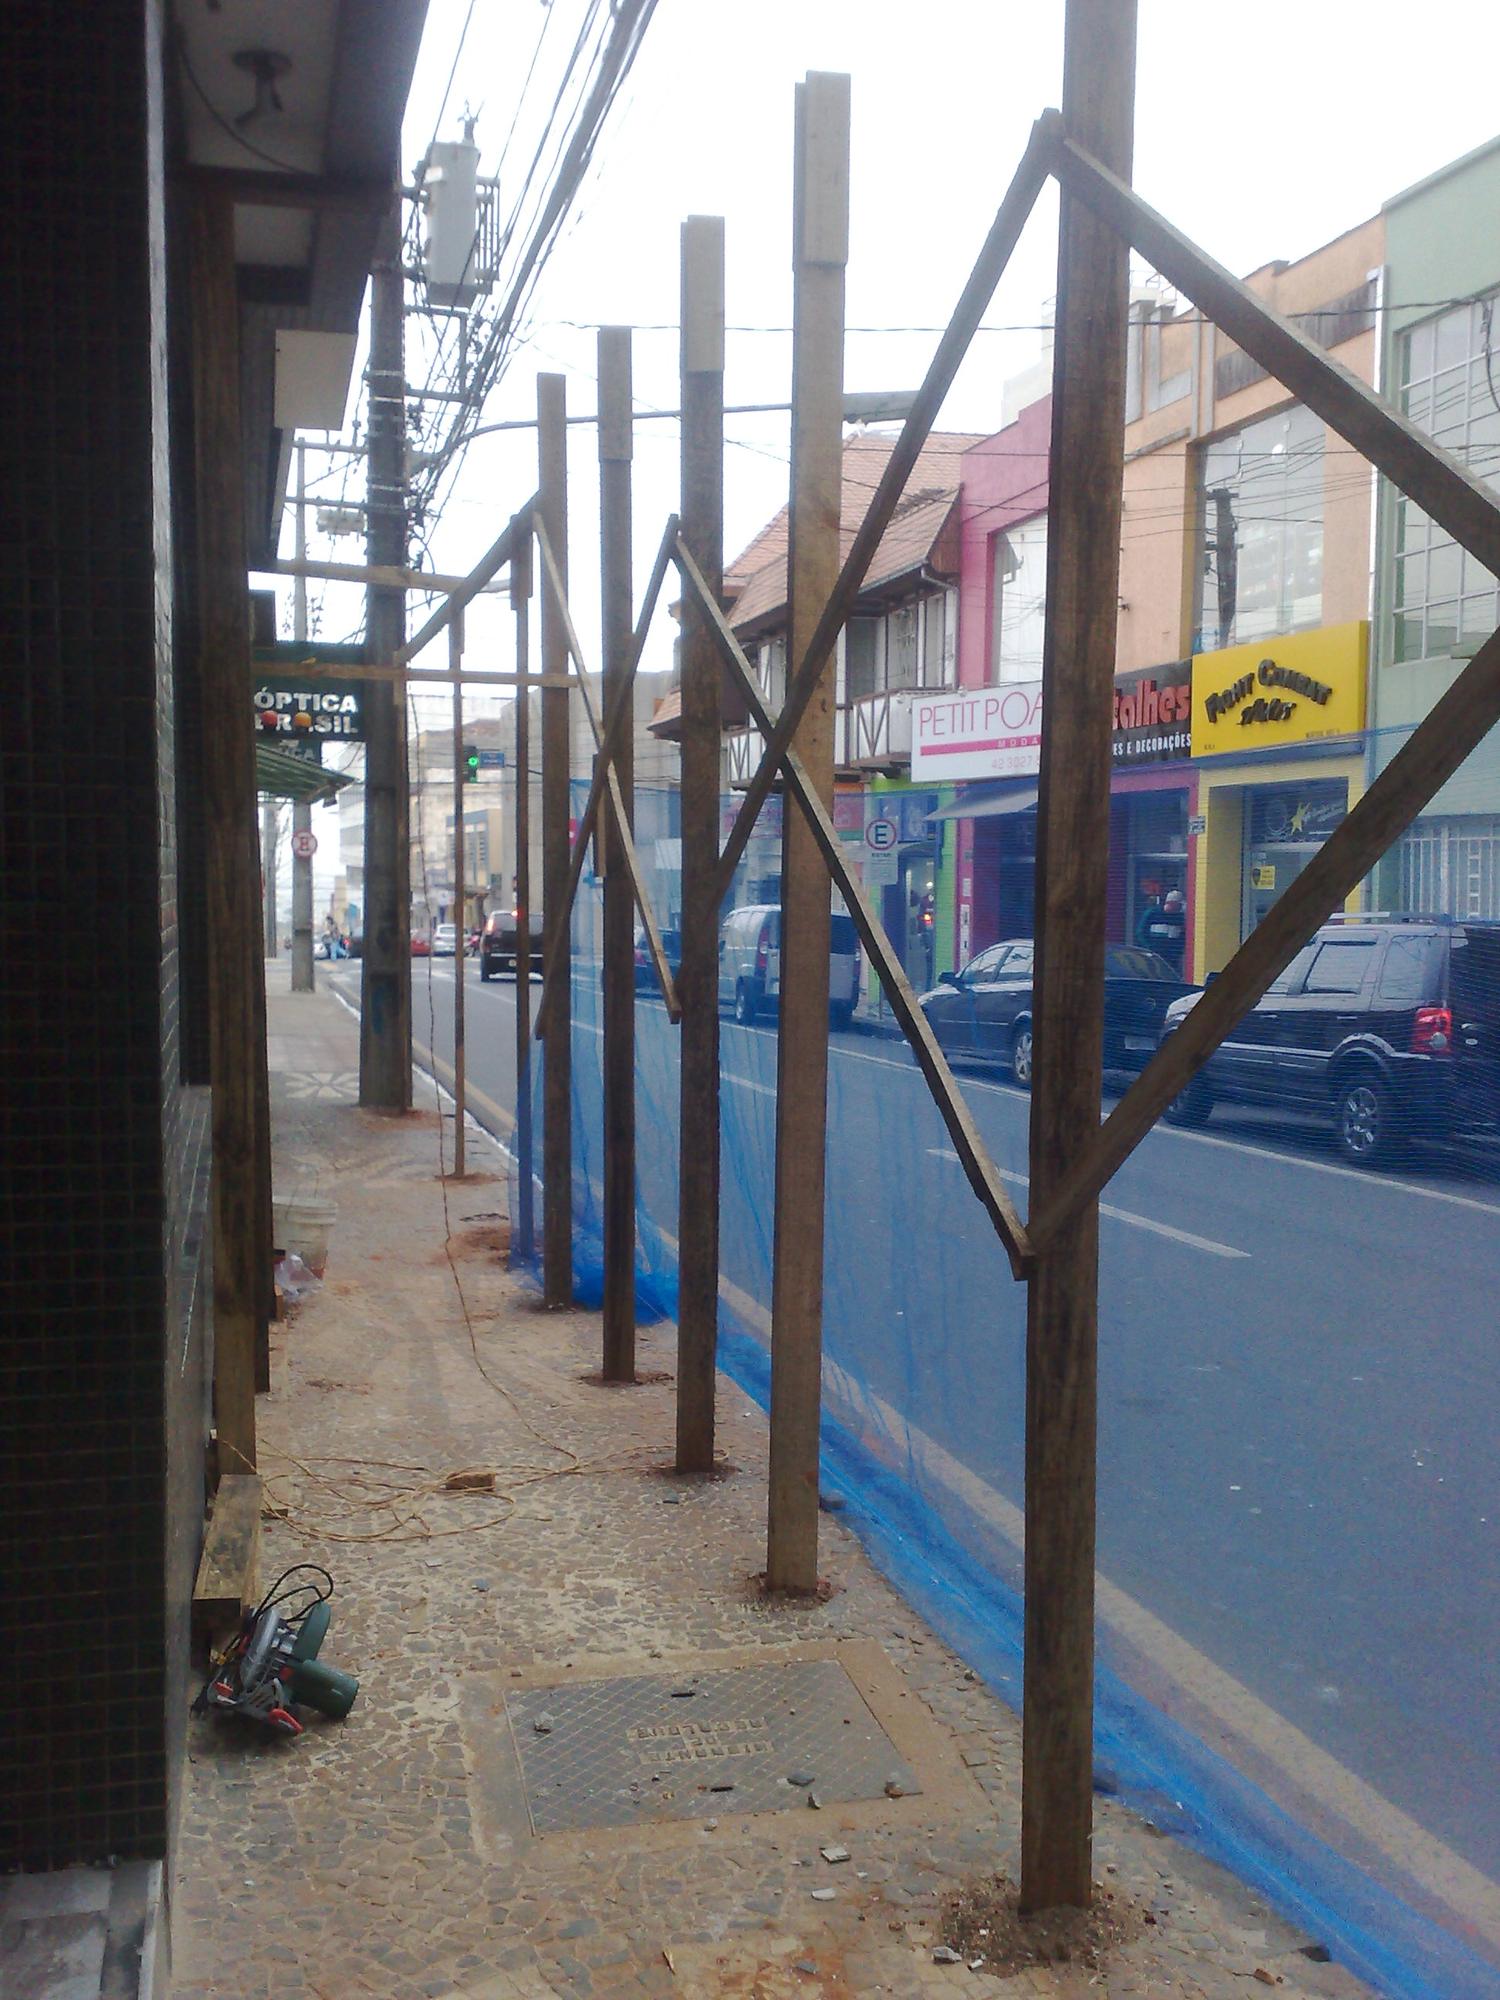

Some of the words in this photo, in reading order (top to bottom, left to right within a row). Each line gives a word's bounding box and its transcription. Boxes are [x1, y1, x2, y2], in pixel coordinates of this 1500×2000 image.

[254, 686, 358, 713] ÓPTICA
[254, 711, 359, 734] BRSIL
[919, 700, 981, 737] PETIT
[1135, 731, 1192, 754] DECORAÇÕES
[875, 824, 888, 844] E
